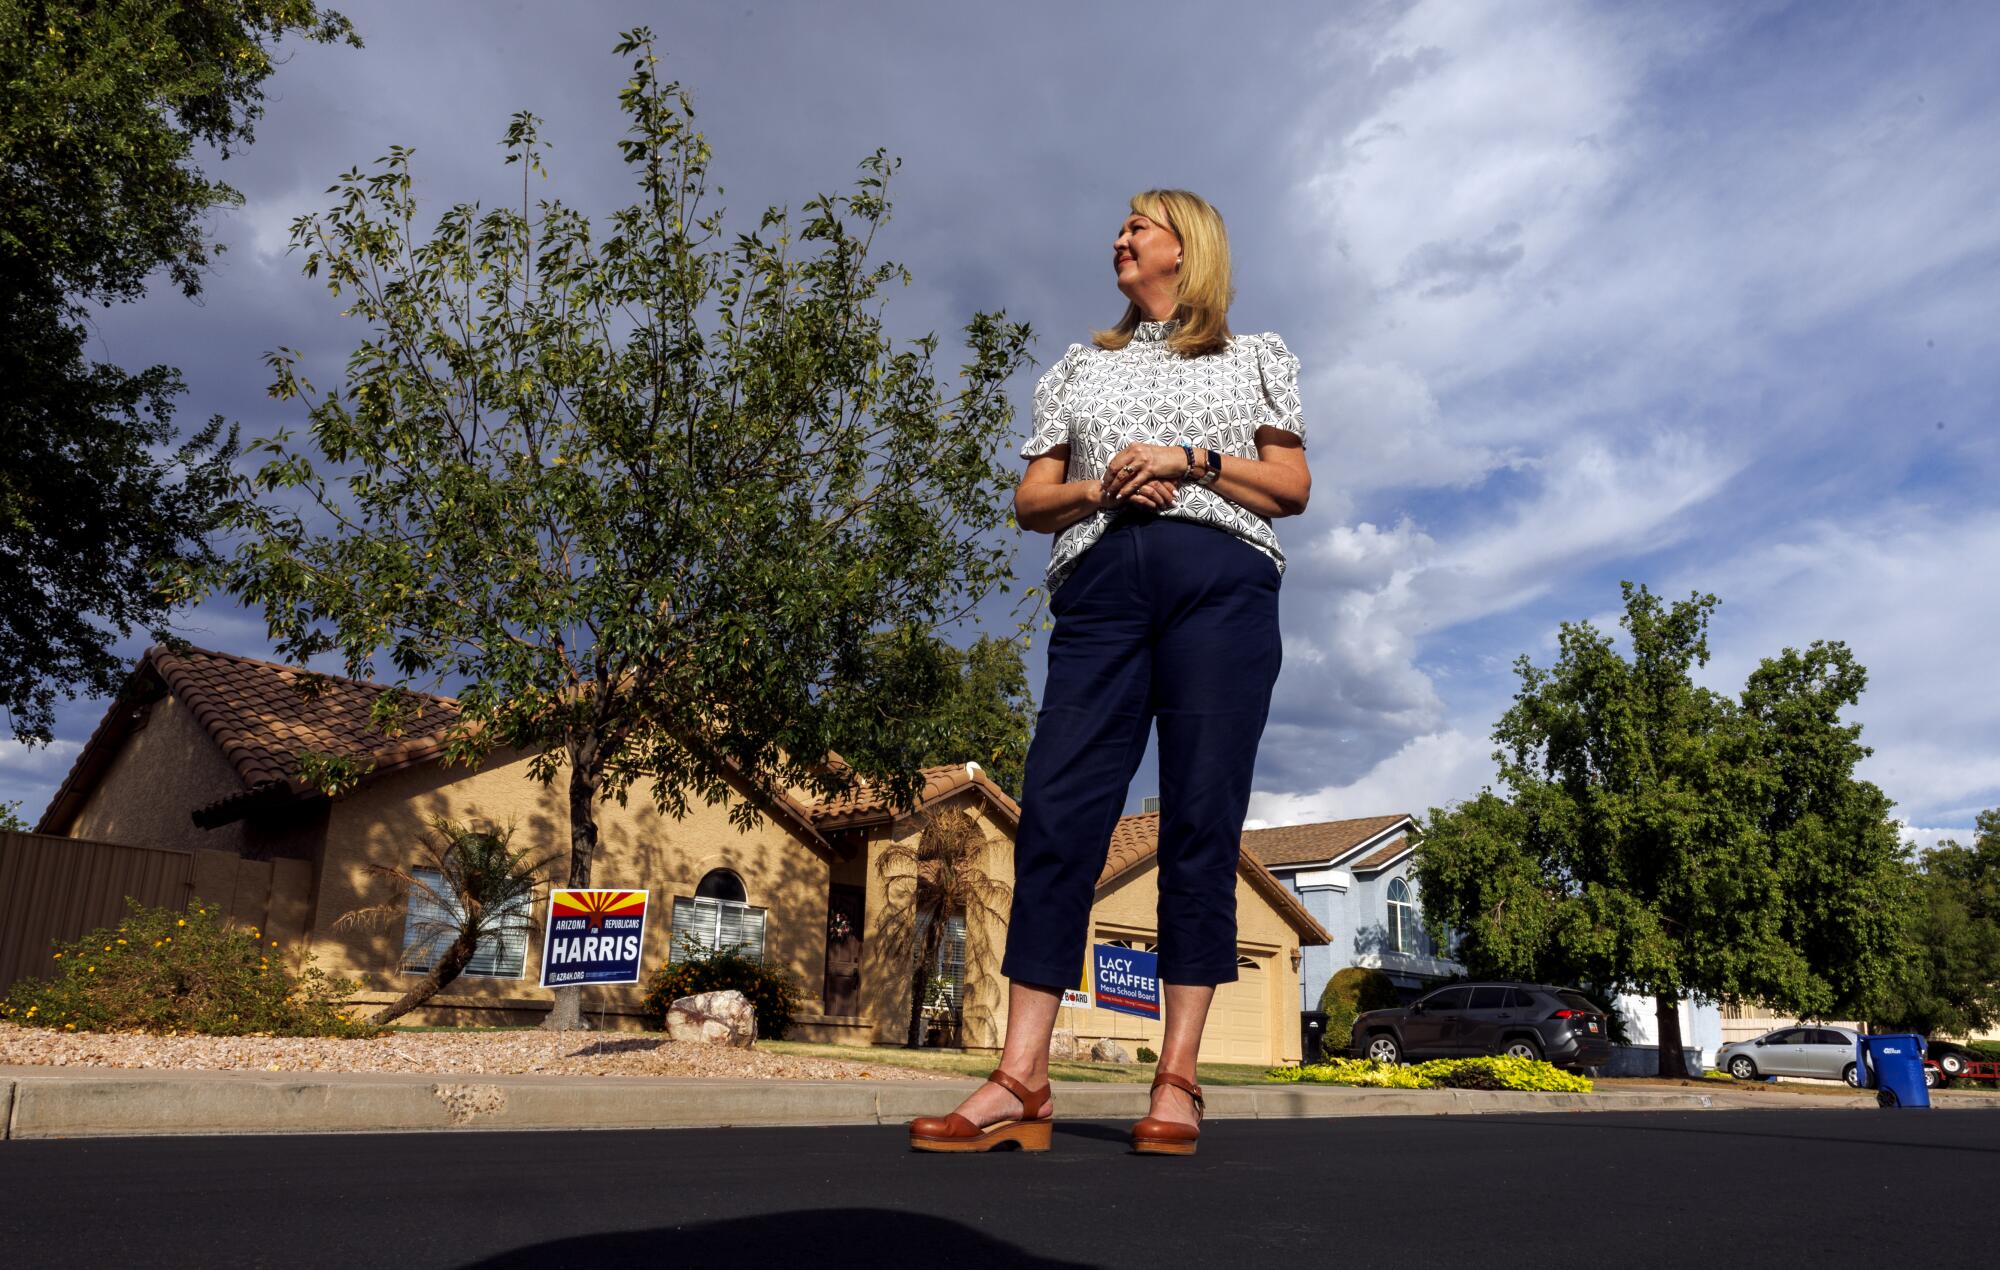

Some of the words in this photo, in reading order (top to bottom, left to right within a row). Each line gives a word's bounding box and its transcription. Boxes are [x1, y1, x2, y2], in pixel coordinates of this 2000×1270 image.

[556, 919, 586, 930] ARIZONA
[604, 919, 640, 929] REPUBLICANS
[551, 935, 638, 964] HARRIS
[1099, 955, 1132, 972] LACY
[1100, 970, 1155, 992] CHAFFEE
[1100, 984, 1116, 993] Mesa
[1116, 986, 1137, 997] School
[1138, 991, 1155, 1002] Board
